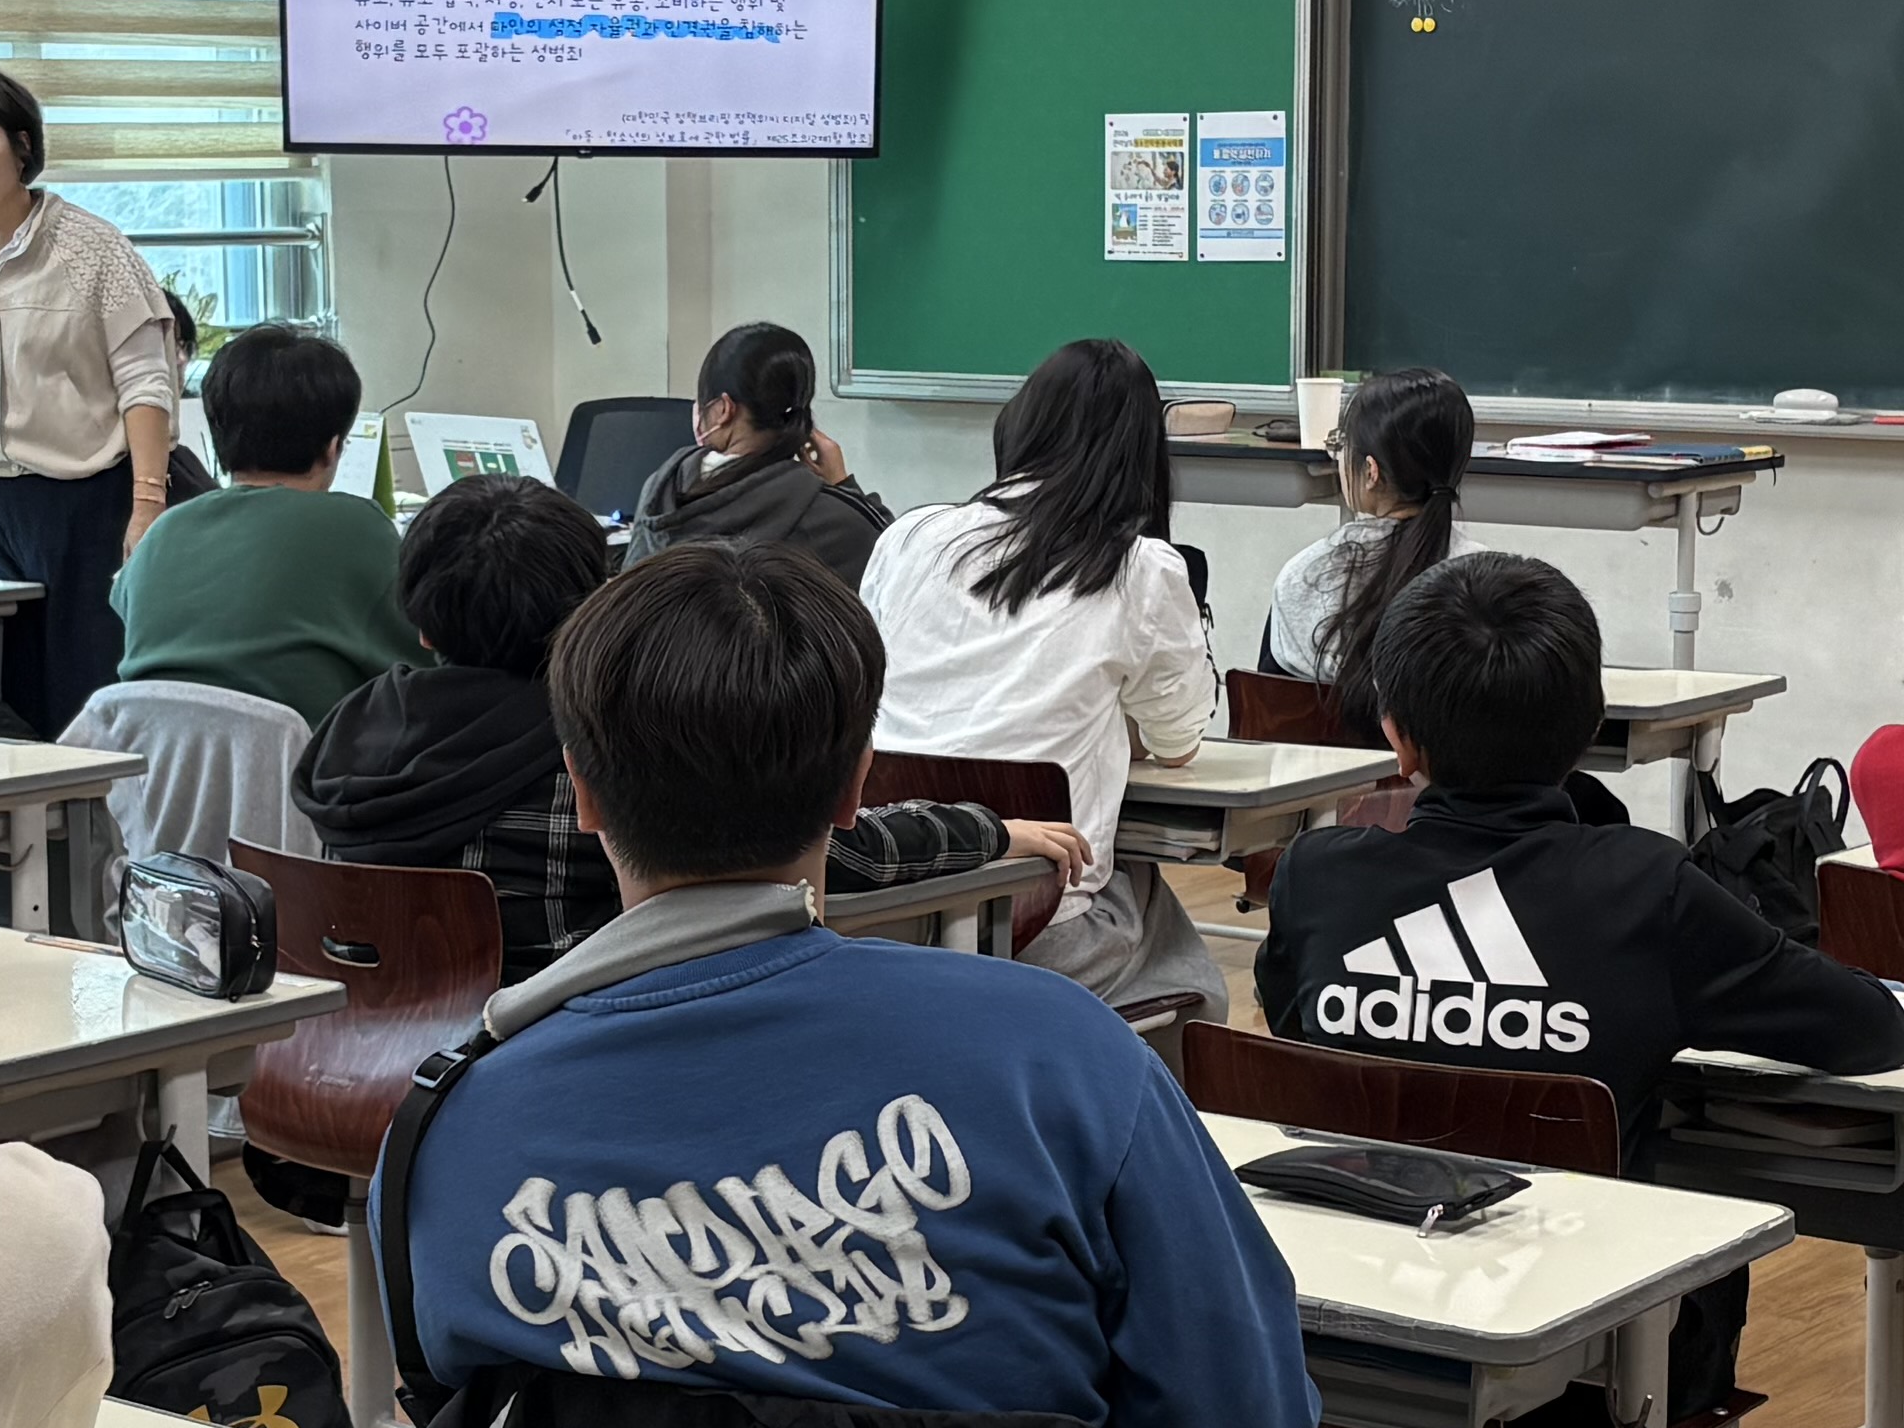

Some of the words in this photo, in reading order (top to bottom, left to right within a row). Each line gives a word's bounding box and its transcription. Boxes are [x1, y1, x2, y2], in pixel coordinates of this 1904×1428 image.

[355, 19, 407, 33] 사이버
[413, 14, 484, 36] 공간에서
[491, 19, 542, 37] 타인의
[355, 39, 407, 62] 행위를
[414, 43, 449, 61] 모두
[455, 42, 524, 63] 포괄하는
[531, 43, 583, 63] 성범죄
[1317, 975, 1591, 1053] adidas
